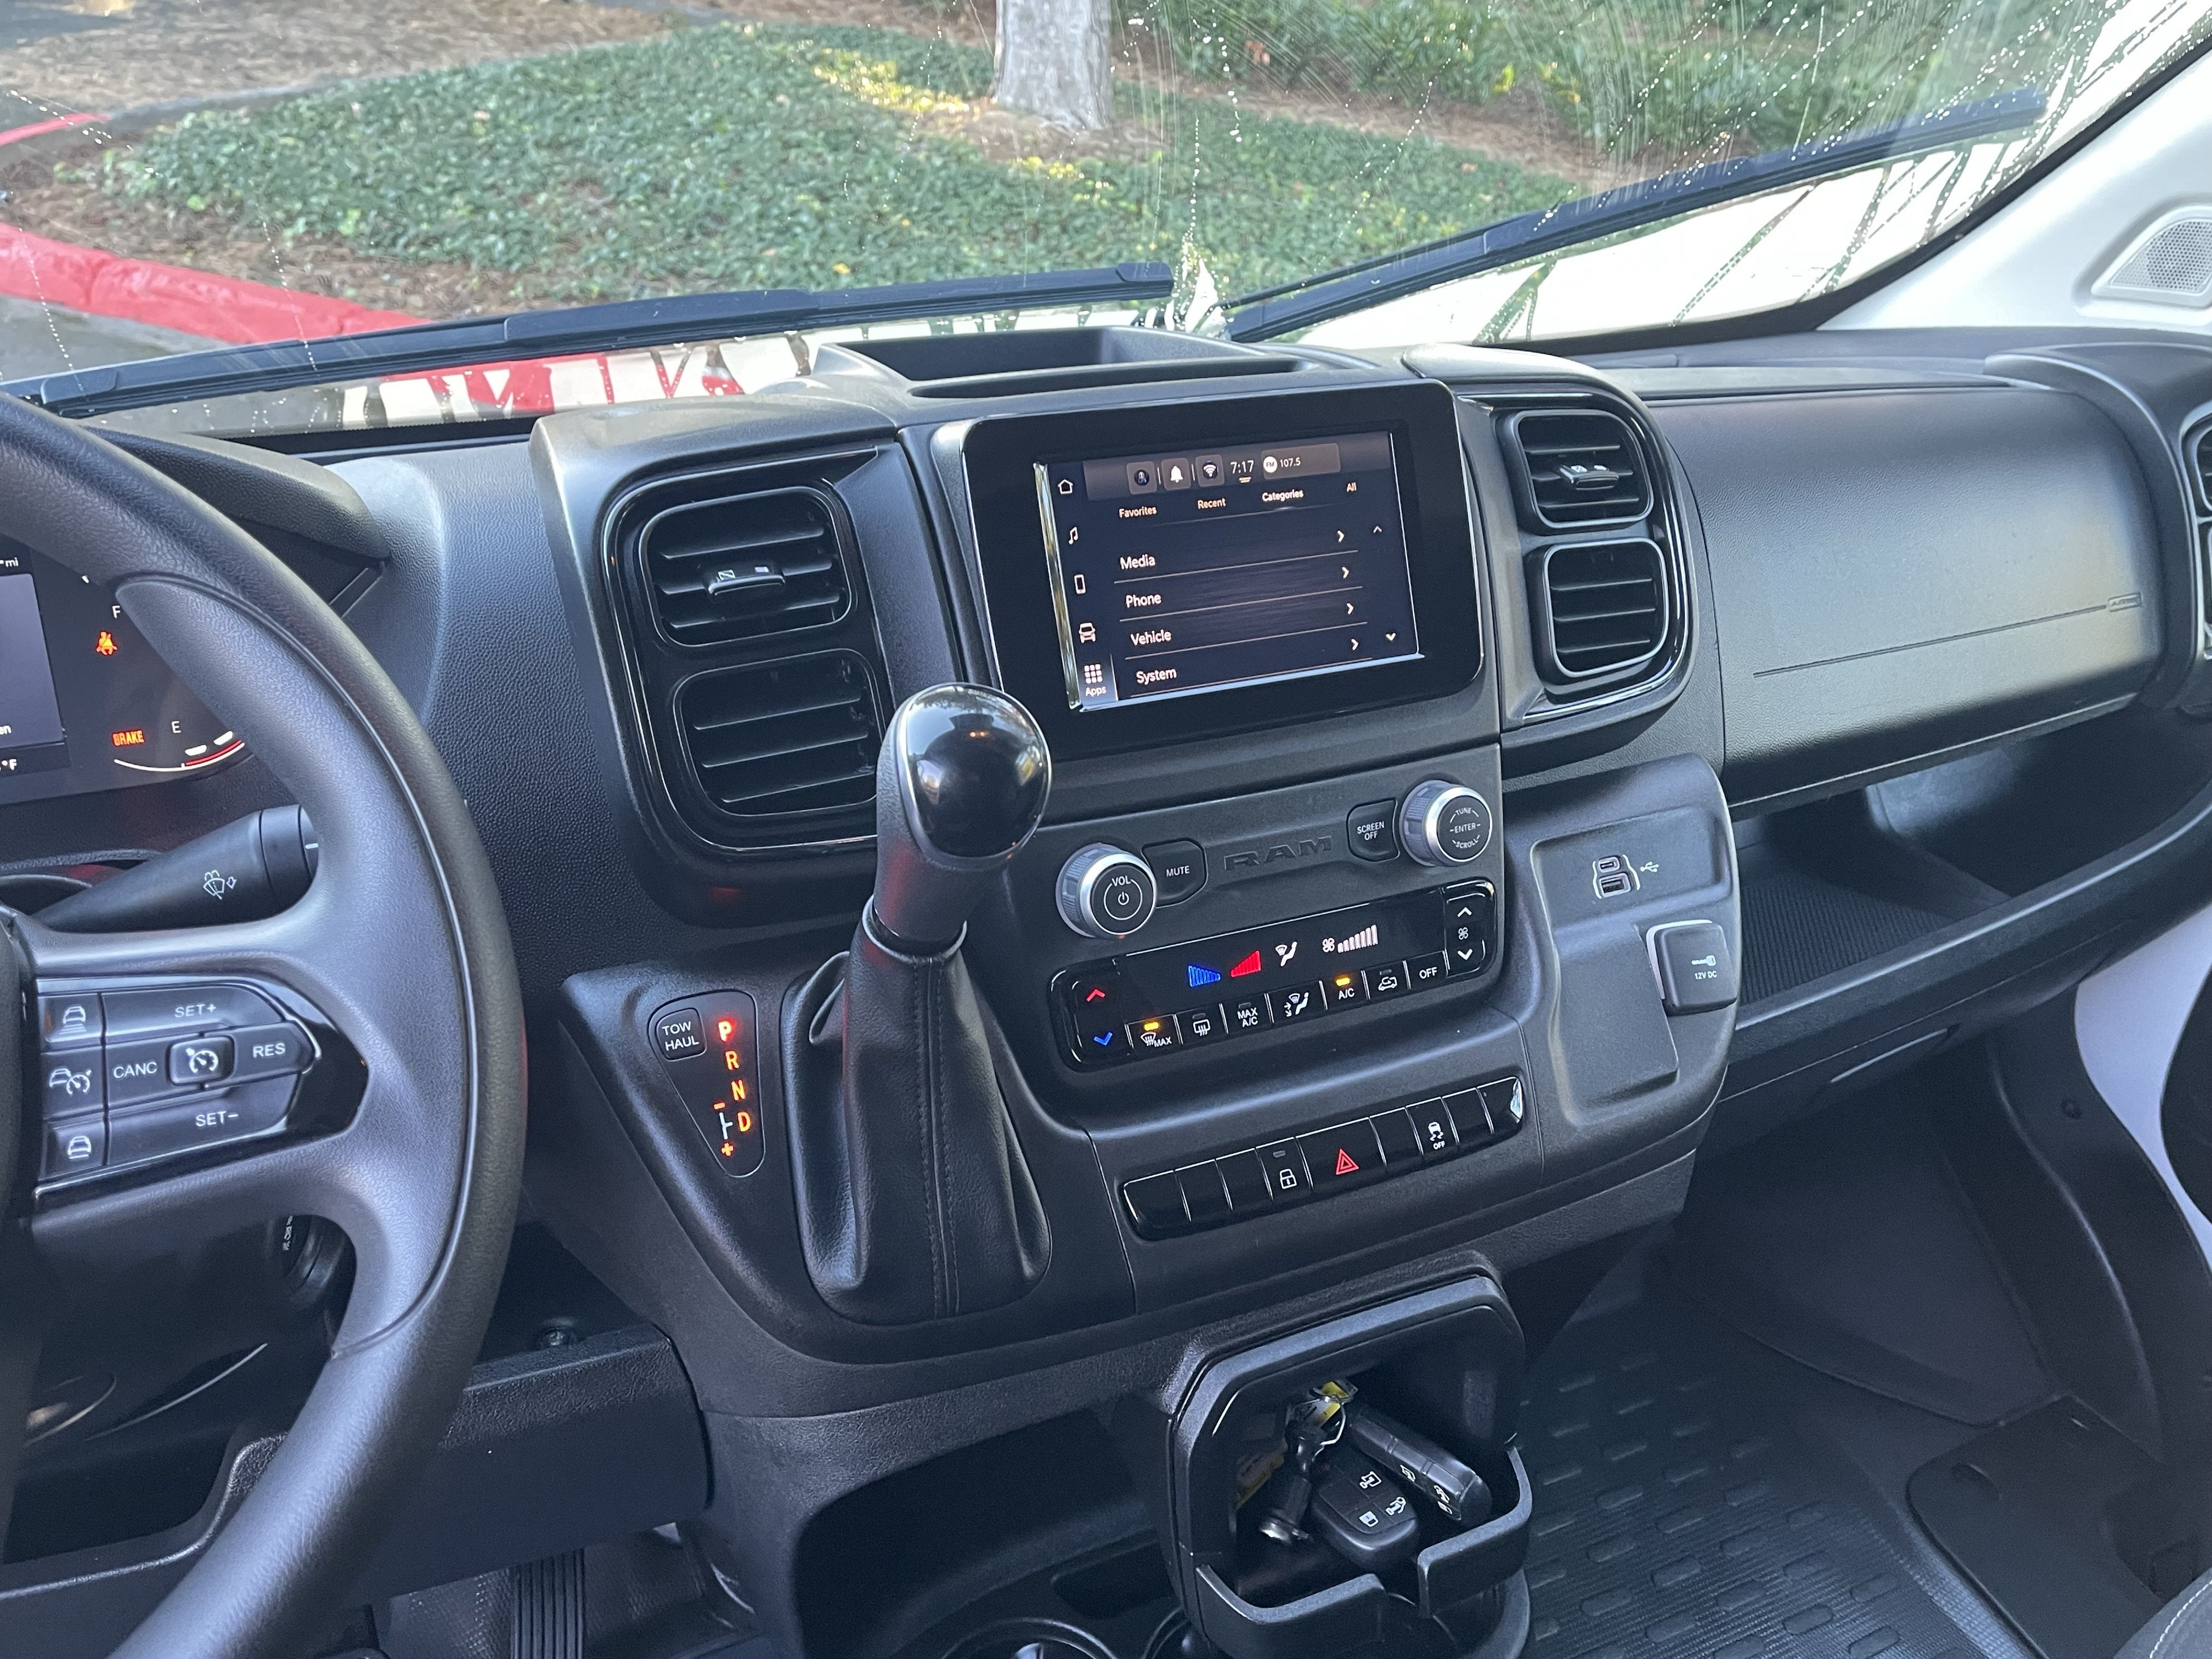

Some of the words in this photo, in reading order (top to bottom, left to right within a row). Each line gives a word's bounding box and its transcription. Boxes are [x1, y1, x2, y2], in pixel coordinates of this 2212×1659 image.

[1230, 460, 1254, 474] 7:17
[1280, 457, 1301, 467] 107.5
[1346, 482, 1357, 492] All
[1262, 489, 1304, 501] Categories
[1197, 498, 1226, 509] Recent
[1119, 506, 1157, 518] Favorites
[1120, 554, 1155, 569] Media
[1126, 594, 1161, 607] Phone
[112, 605, 121, 618] F
[1131, 629, 1171, 645] Vehicle
[1136, 669, 1177, 685] System
[1085, 686, 1106, 697] Apps
[171, 720, 181, 733] E
[113, 730, 144, 745] BRAKE
[1455, 807, 1472, 816] TUNE
[1357, 821, 1385, 834] SCREEN
[1454, 823, 1476, 834] ENTER
[1364, 831, 1378, 841] OFF
[1455, 838, 1479, 849] SCROLL
[1224, 835, 1332, 871] RAM
[1166, 865, 1190, 877] MUTE
[1111, 876, 1131, 887] VOL
[1419, 967, 1437, 979] OFF
[1694, 971, 1707, 980] 12V
[1707, 970, 1717, 979] DC
[1338, 988, 1355, 1001] A/C
[1237, 1007, 1258, 1019] MAX
[1242, 1015, 1259, 1028] A/C
[662, 1021, 691, 1036] TOW
[718, 1021, 731, 1041] P
[665, 1036, 699, 1051] HAUL
[1154, 1036, 1172, 1048] MAX
[253, 1043, 286, 1058] RES
[725, 1051, 739, 1070] R
[113, 1062, 157, 1079] CANC
[731, 1079, 746, 1101] N
[737, 1111, 751, 1132] D
[1433, 1141, 1445, 1150] OFF
